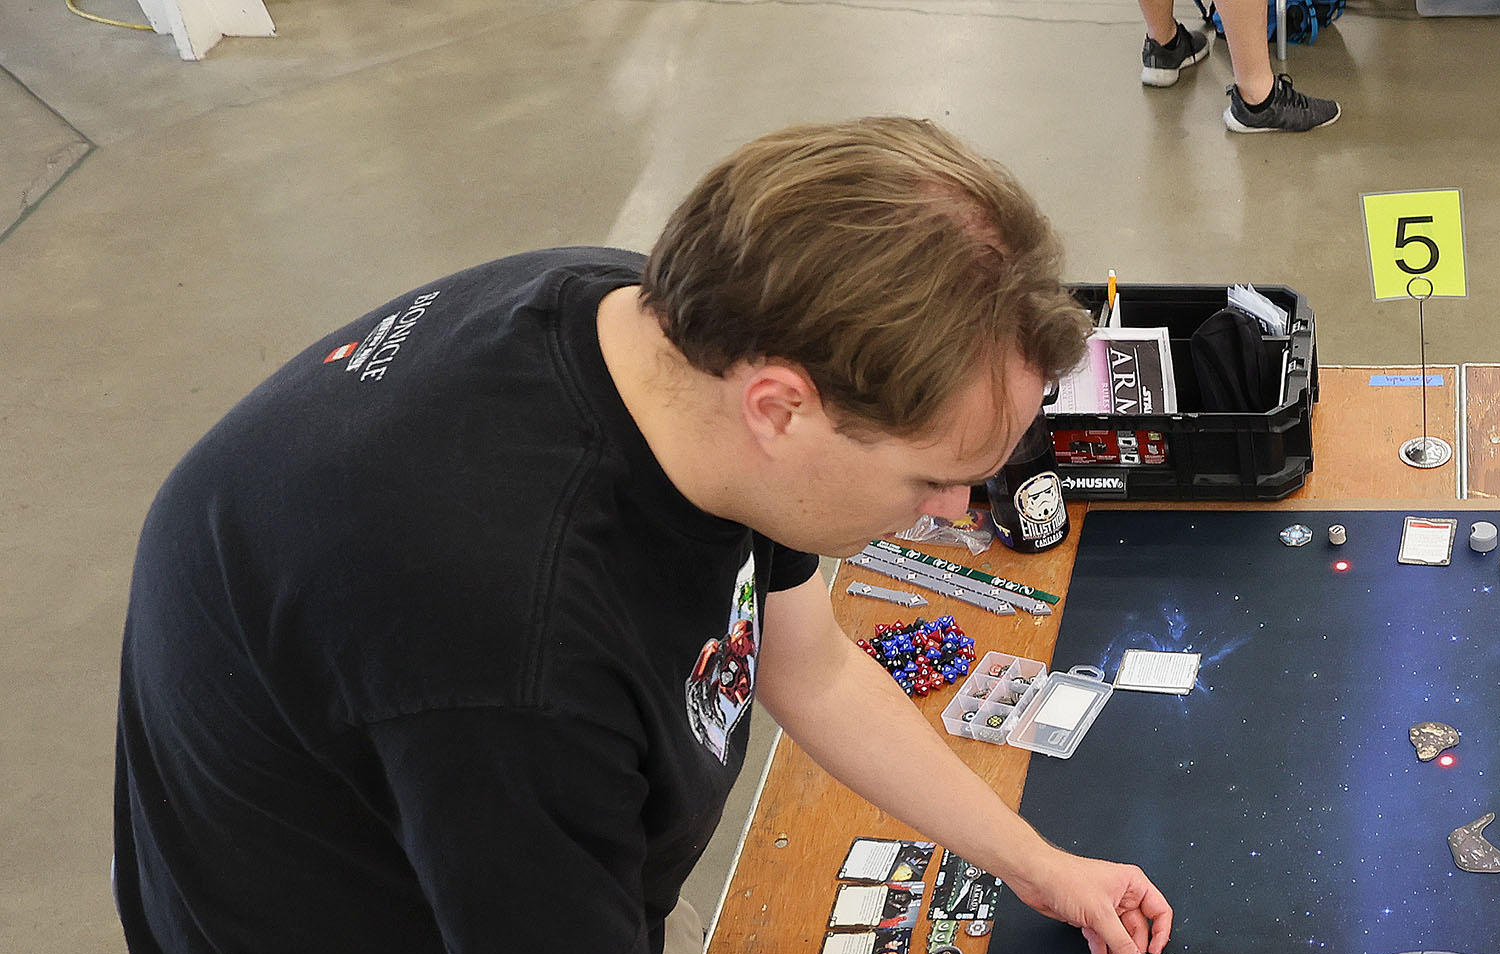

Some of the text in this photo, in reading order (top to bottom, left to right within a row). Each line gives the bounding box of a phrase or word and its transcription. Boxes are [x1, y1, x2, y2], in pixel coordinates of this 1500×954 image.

[1394, 216, 1440, 275] 5
[360, 290, 440, 382] BIONICLE
[1110, 347, 1138, 414] ARM
[1142, 385, 1153, 414] STA
[1076, 478, 1120, 489] HUSKY
